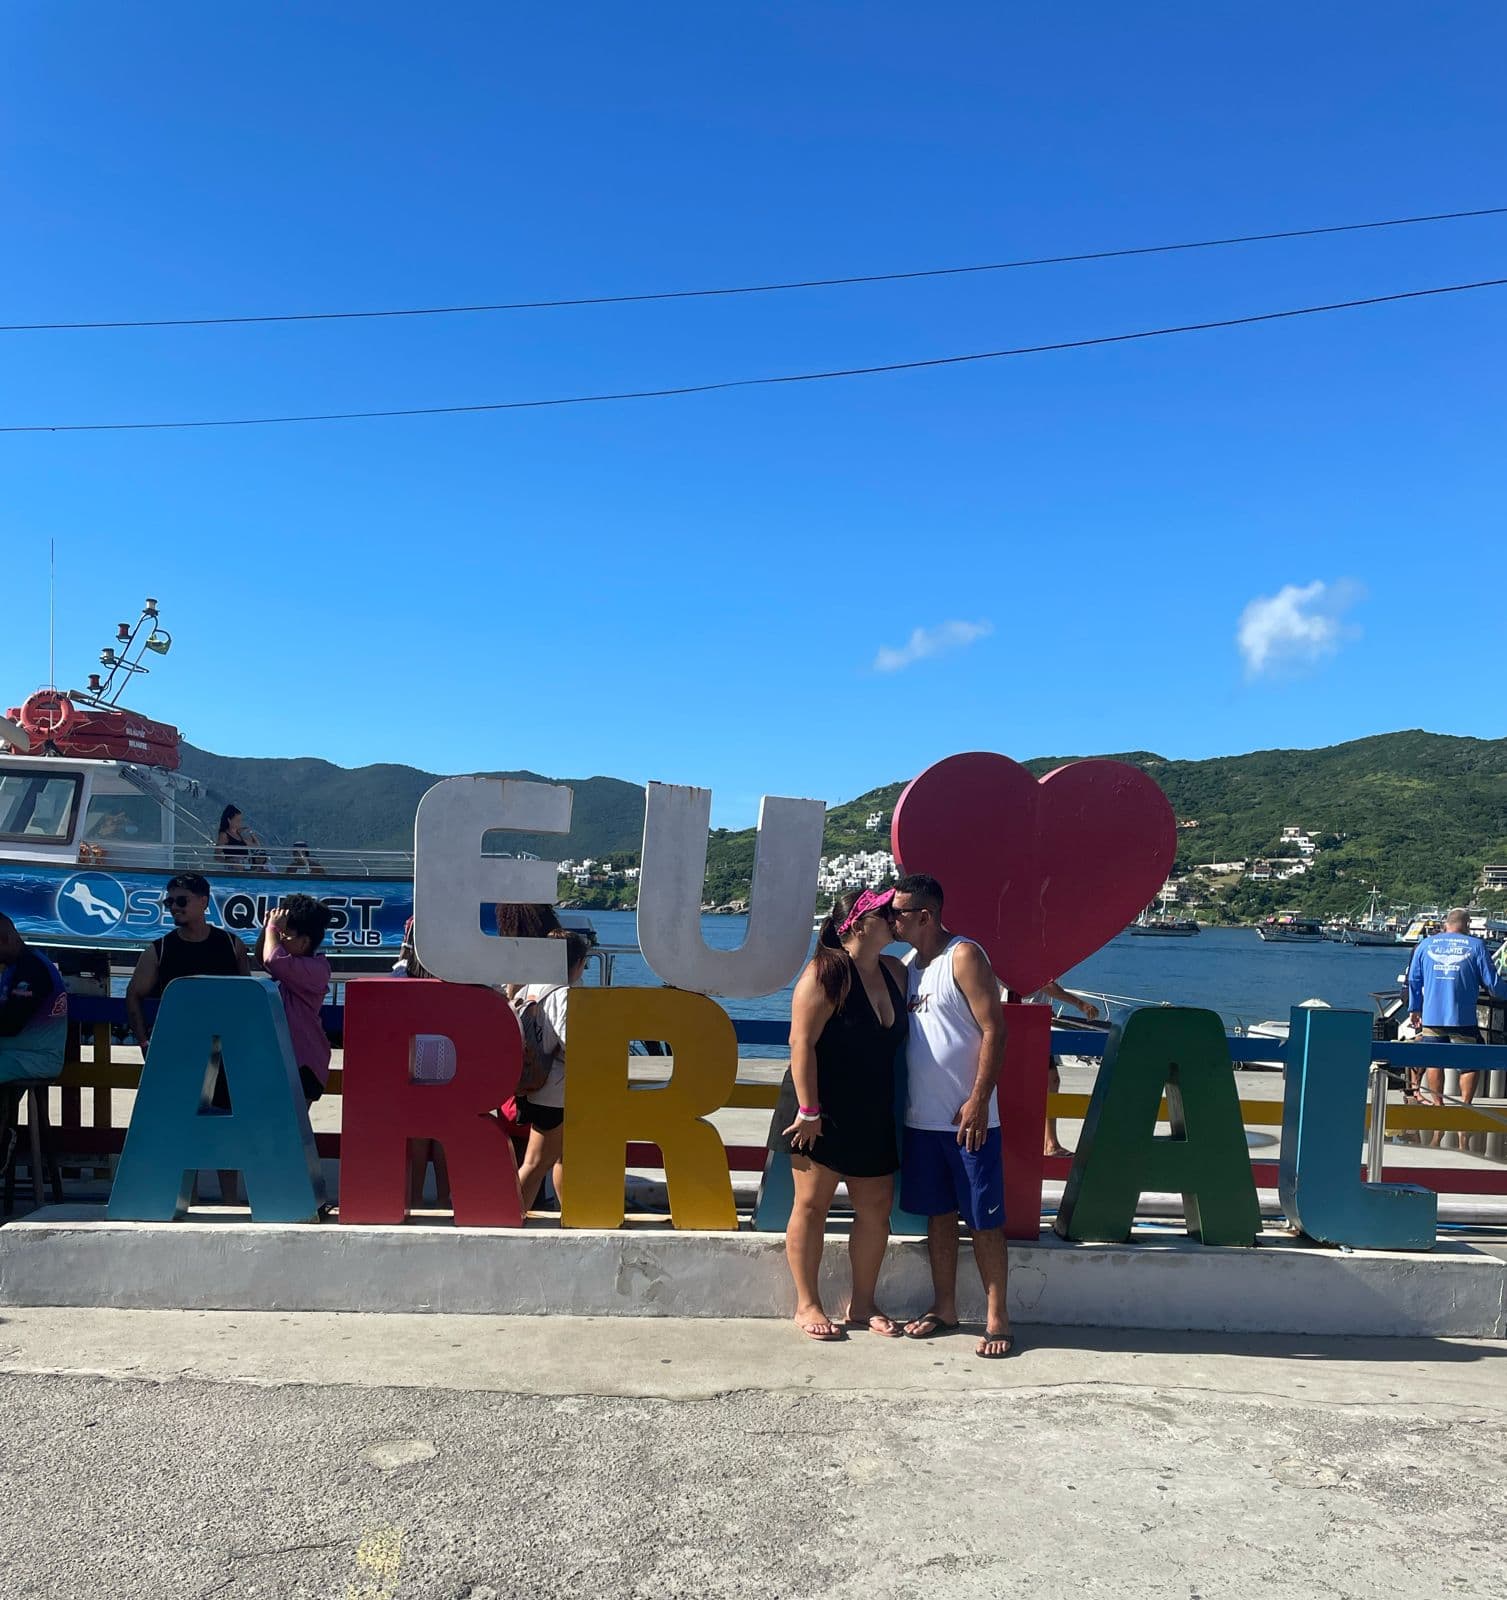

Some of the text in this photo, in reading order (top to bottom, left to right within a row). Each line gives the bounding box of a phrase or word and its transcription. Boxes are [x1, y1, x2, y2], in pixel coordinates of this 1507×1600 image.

[126, 889, 384, 931] SAQUST
[332, 930, 383, 947] SUB
[413, 776, 826, 998] EU
[106, 975, 1437, 1250] ARRIAL
